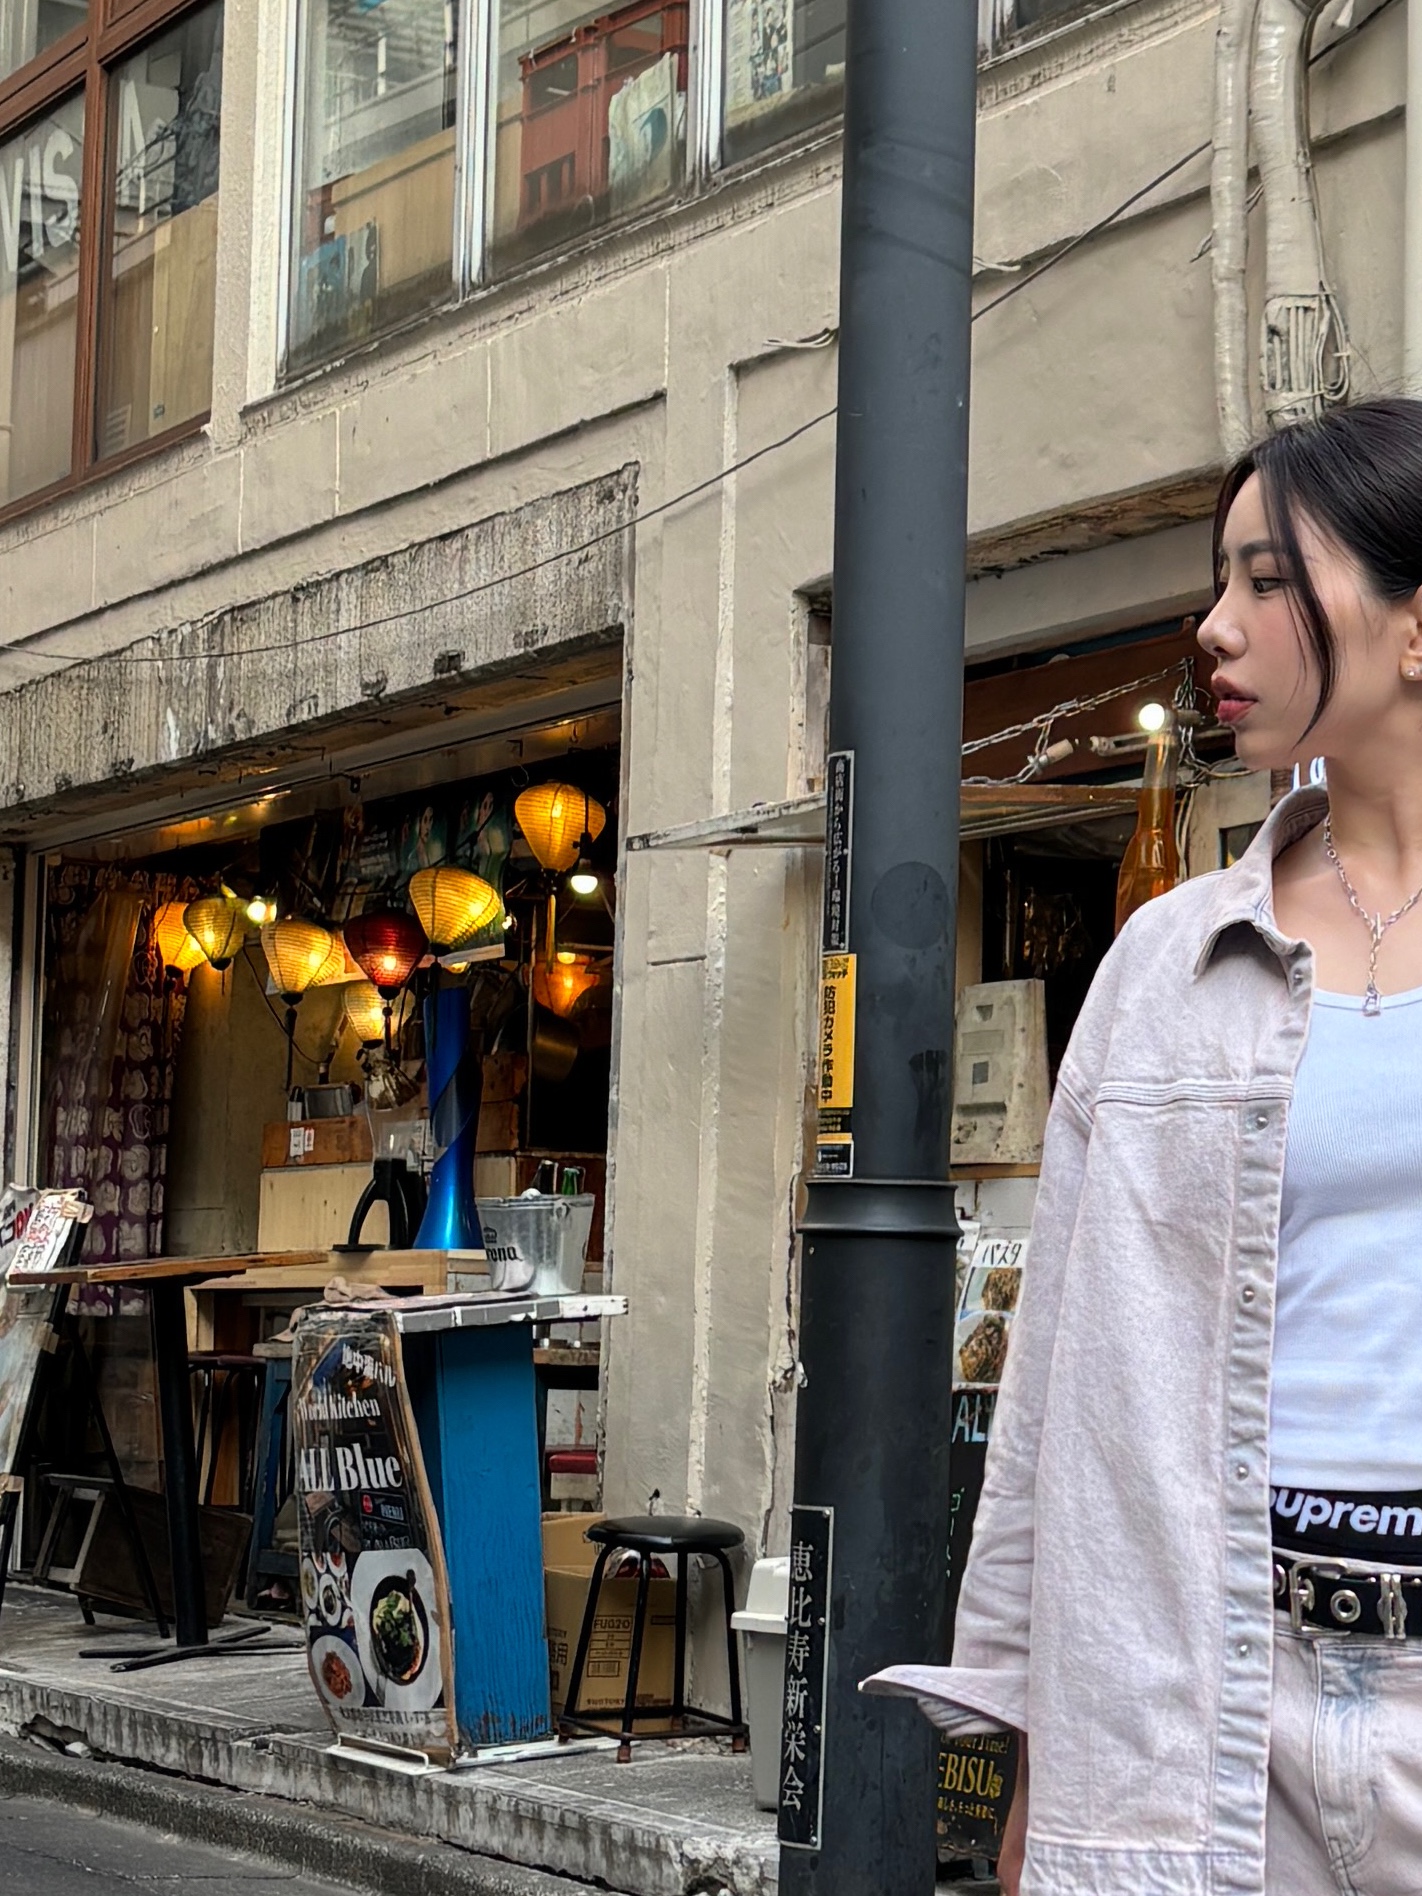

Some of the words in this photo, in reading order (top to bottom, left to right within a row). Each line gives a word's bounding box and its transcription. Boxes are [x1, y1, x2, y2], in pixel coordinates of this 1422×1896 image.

[336, 1442, 403, 1492] Blue
[781, 1541, 814, 1812] 恵比寿新栄会
